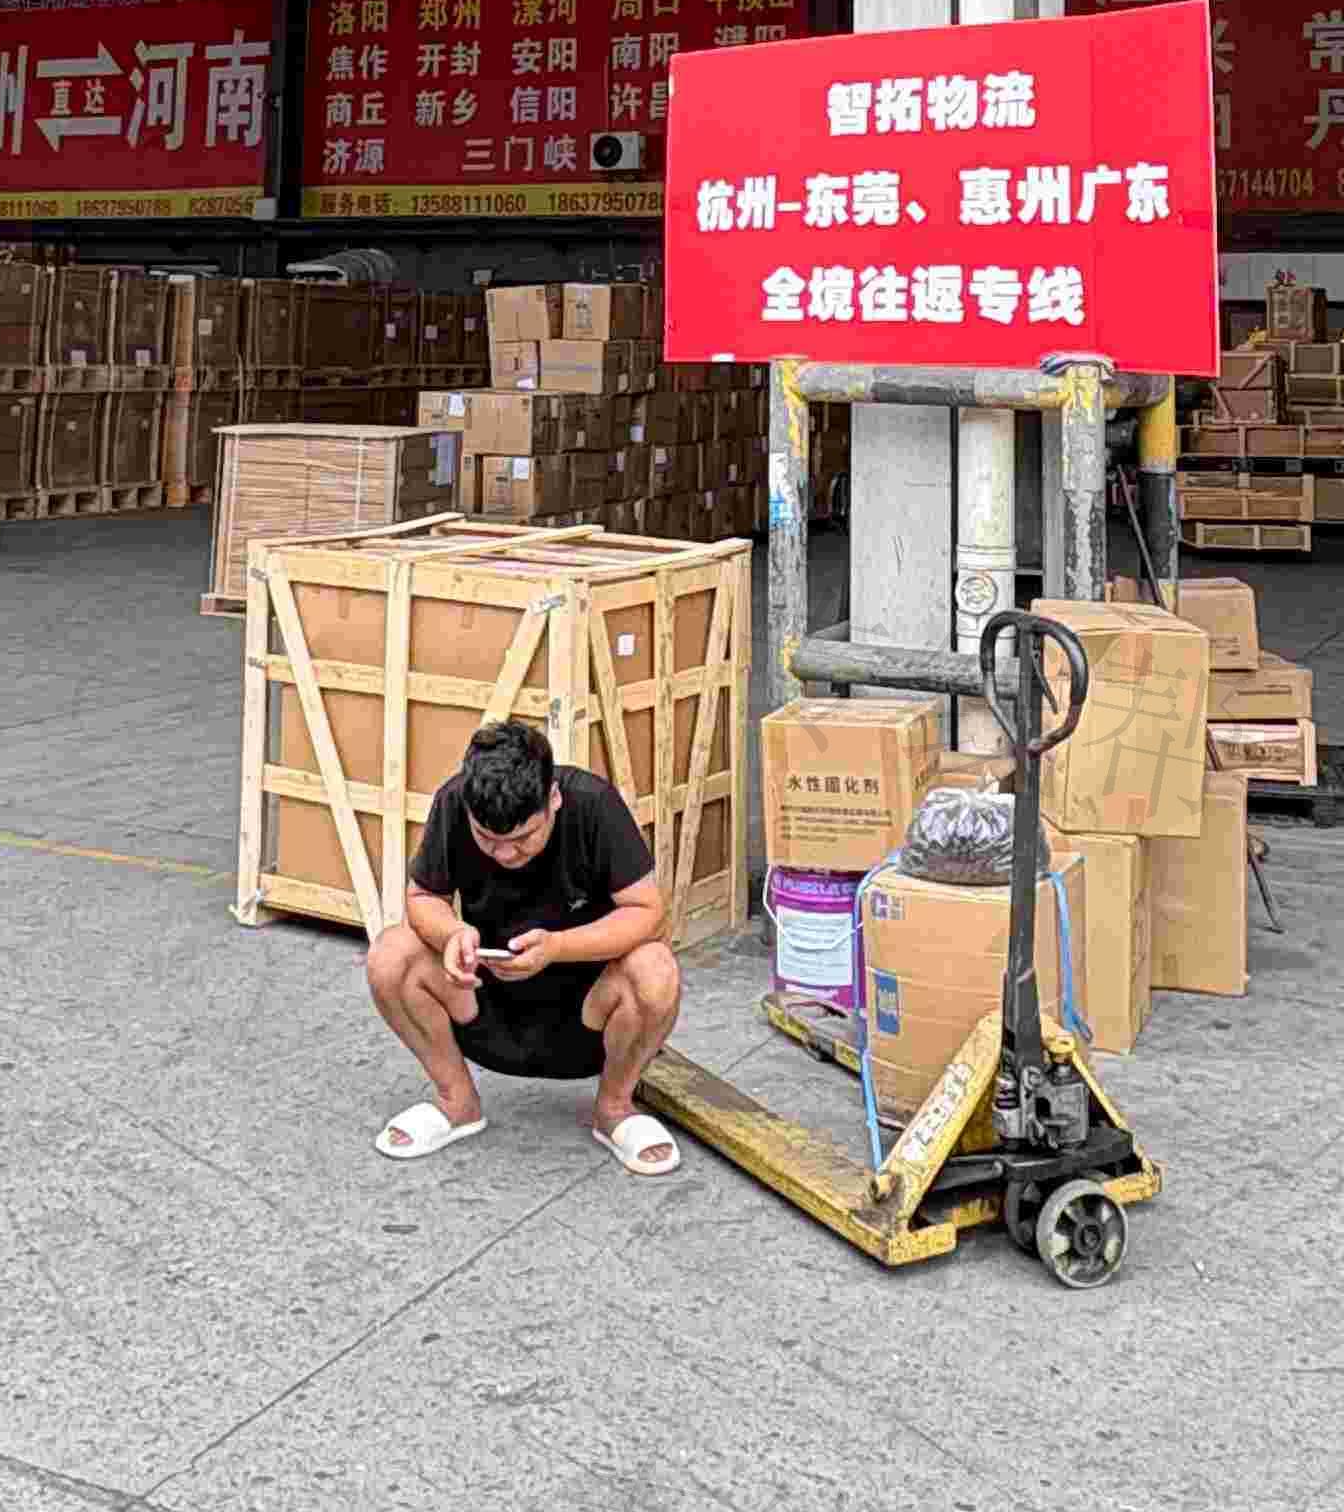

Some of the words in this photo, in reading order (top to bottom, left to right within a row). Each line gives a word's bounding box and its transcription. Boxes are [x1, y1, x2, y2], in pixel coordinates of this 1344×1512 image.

[328, 0, 389, 36] 洛阳
[325, 46, 389, 82] 焦作
[416, 42, 482, 78] 开封
[511, 37, 578, 75] 安阳
[611, 31, 680, 71] 南阳
[50, 77, 106, 117] 直达
[127, 26, 272, 152] 河南
[325, 92, 387, 130] 商丘
[414, 90, 480, 127] 新乡
[509, 85, 578, 124] 信阳
[826, 69, 1037, 136] 智拓物流
[322, 138, 385, 174] 济源
[461, 135, 577, 172] 三门峡
[411, 192, 527, 214] 13588111060
[760, 265, 1087, 326] 全境往返专线
[787, 775, 880, 795] 水性固化剂
